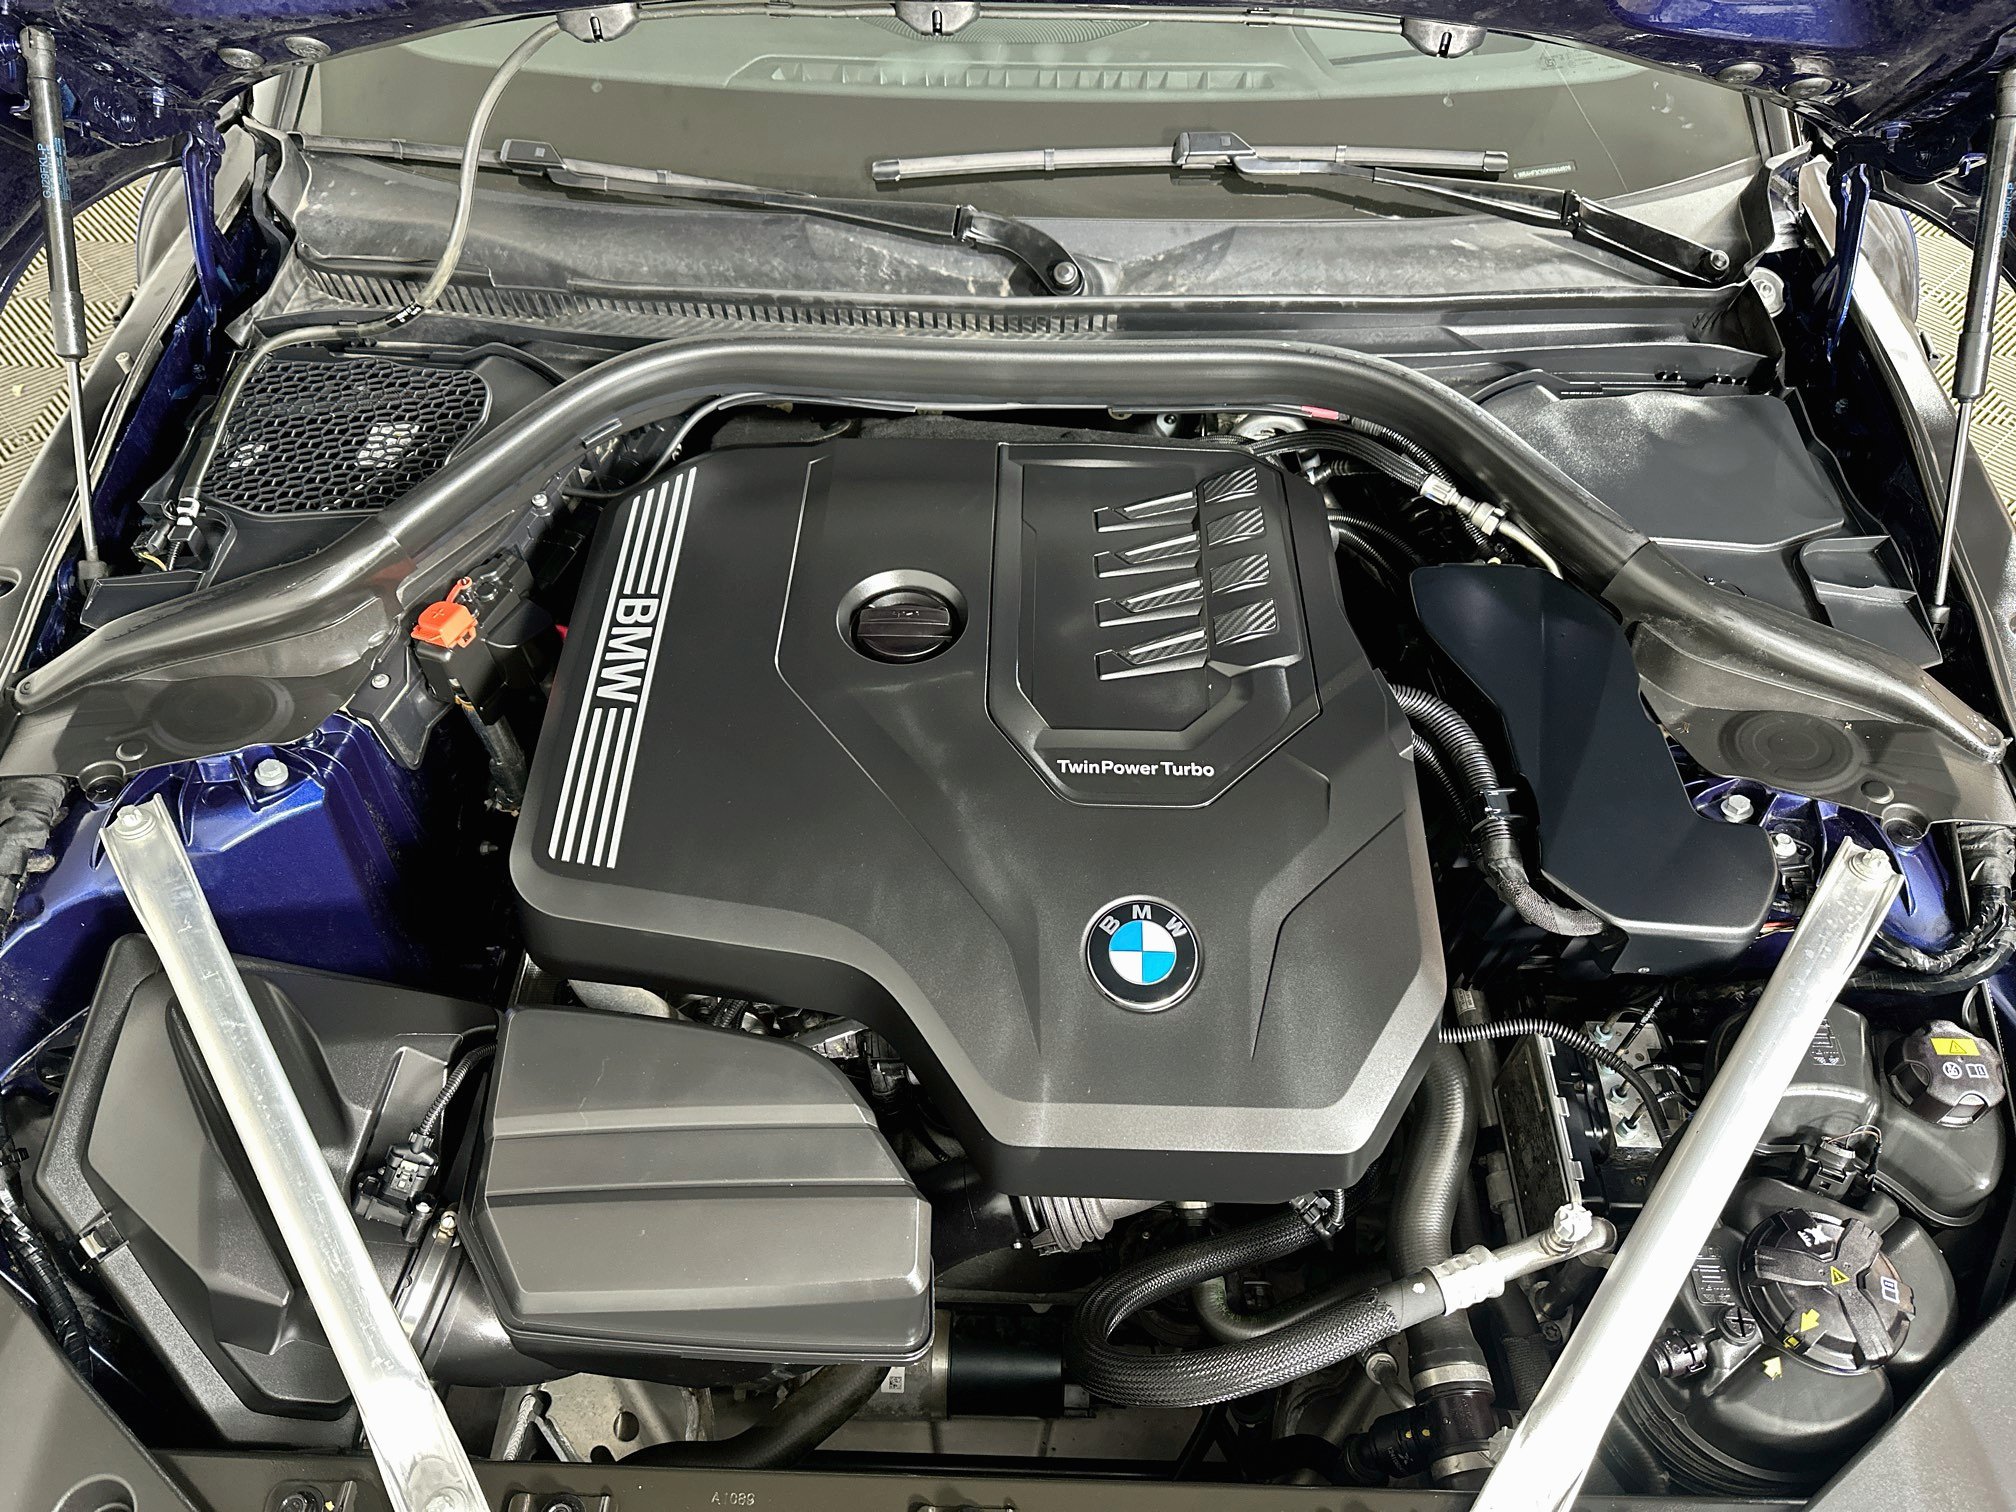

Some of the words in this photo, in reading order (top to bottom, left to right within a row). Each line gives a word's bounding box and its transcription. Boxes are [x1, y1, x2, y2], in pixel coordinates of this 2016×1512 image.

[37, 142, 52, 199] GJ29FKL-P
[596, 598, 659, 703] BMW
[1160, 761, 1216, 778] Turbo
[1098, 904, 1188, 938] BMW
